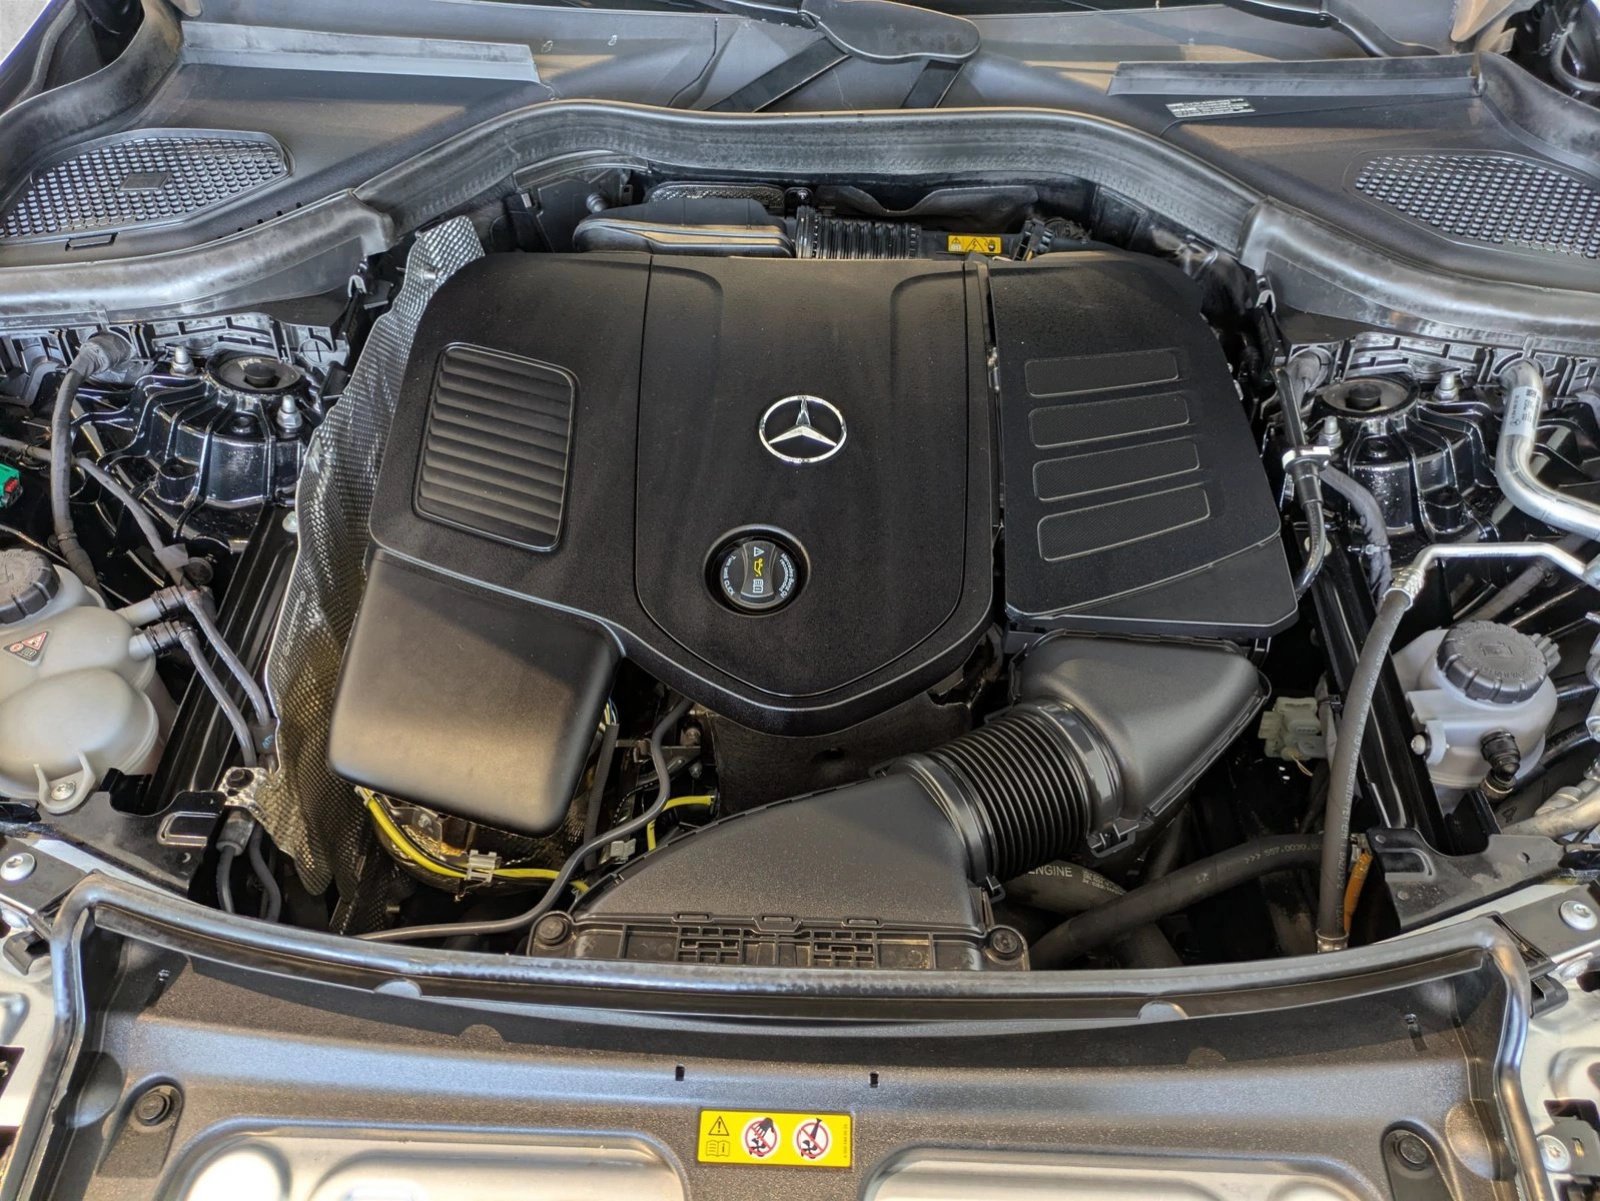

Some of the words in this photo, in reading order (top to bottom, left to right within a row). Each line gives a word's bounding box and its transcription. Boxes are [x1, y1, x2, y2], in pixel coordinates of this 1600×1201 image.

[726, 555, 737, 567] Turn
[781, 553, 795, 590] Mercedes-Benz
[724, 580, 735, 596] CLICK
[1028, 865, 1073, 878] NGINE
